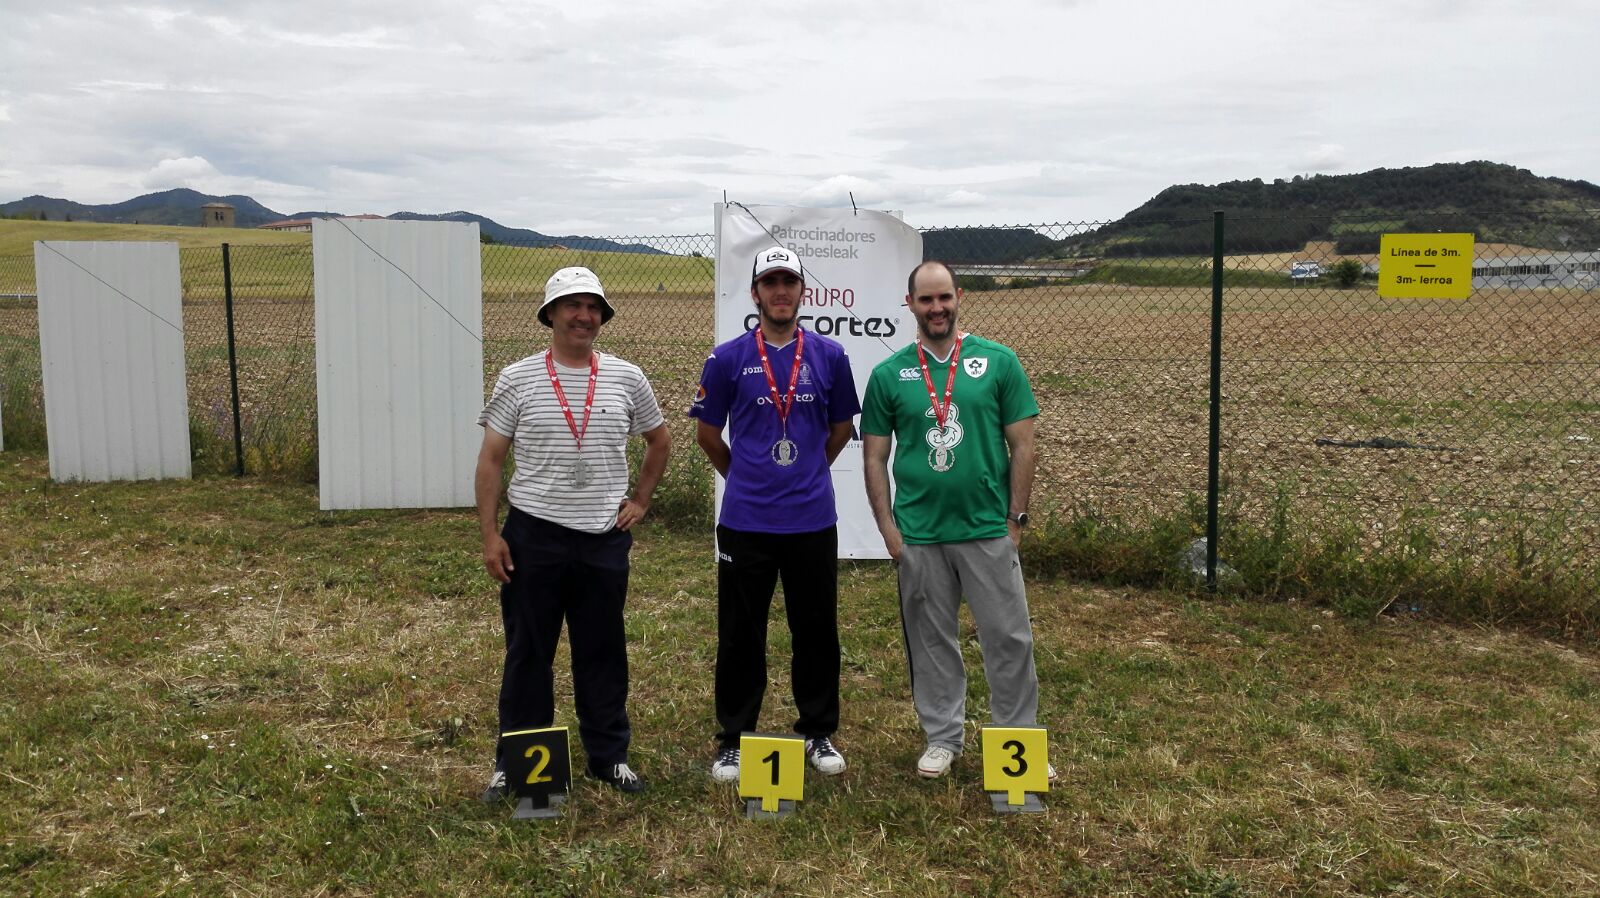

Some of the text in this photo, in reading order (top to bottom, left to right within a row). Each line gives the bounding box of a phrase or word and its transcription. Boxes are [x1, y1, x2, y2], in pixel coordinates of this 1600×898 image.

[771, 225, 876, 243] Patrocinadores
[787, 243, 859, 259] Babesleak
[1391, 247, 1461, 257] Línea de 3m.
[1396, 275, 1453, 285] 3m- lerroa
[802, 287, 855, 308] RUPO
[524, 745, 552, 784] 2
[762, 750, 780, 786] 1
[1002, 740, 1028, 778] 3
